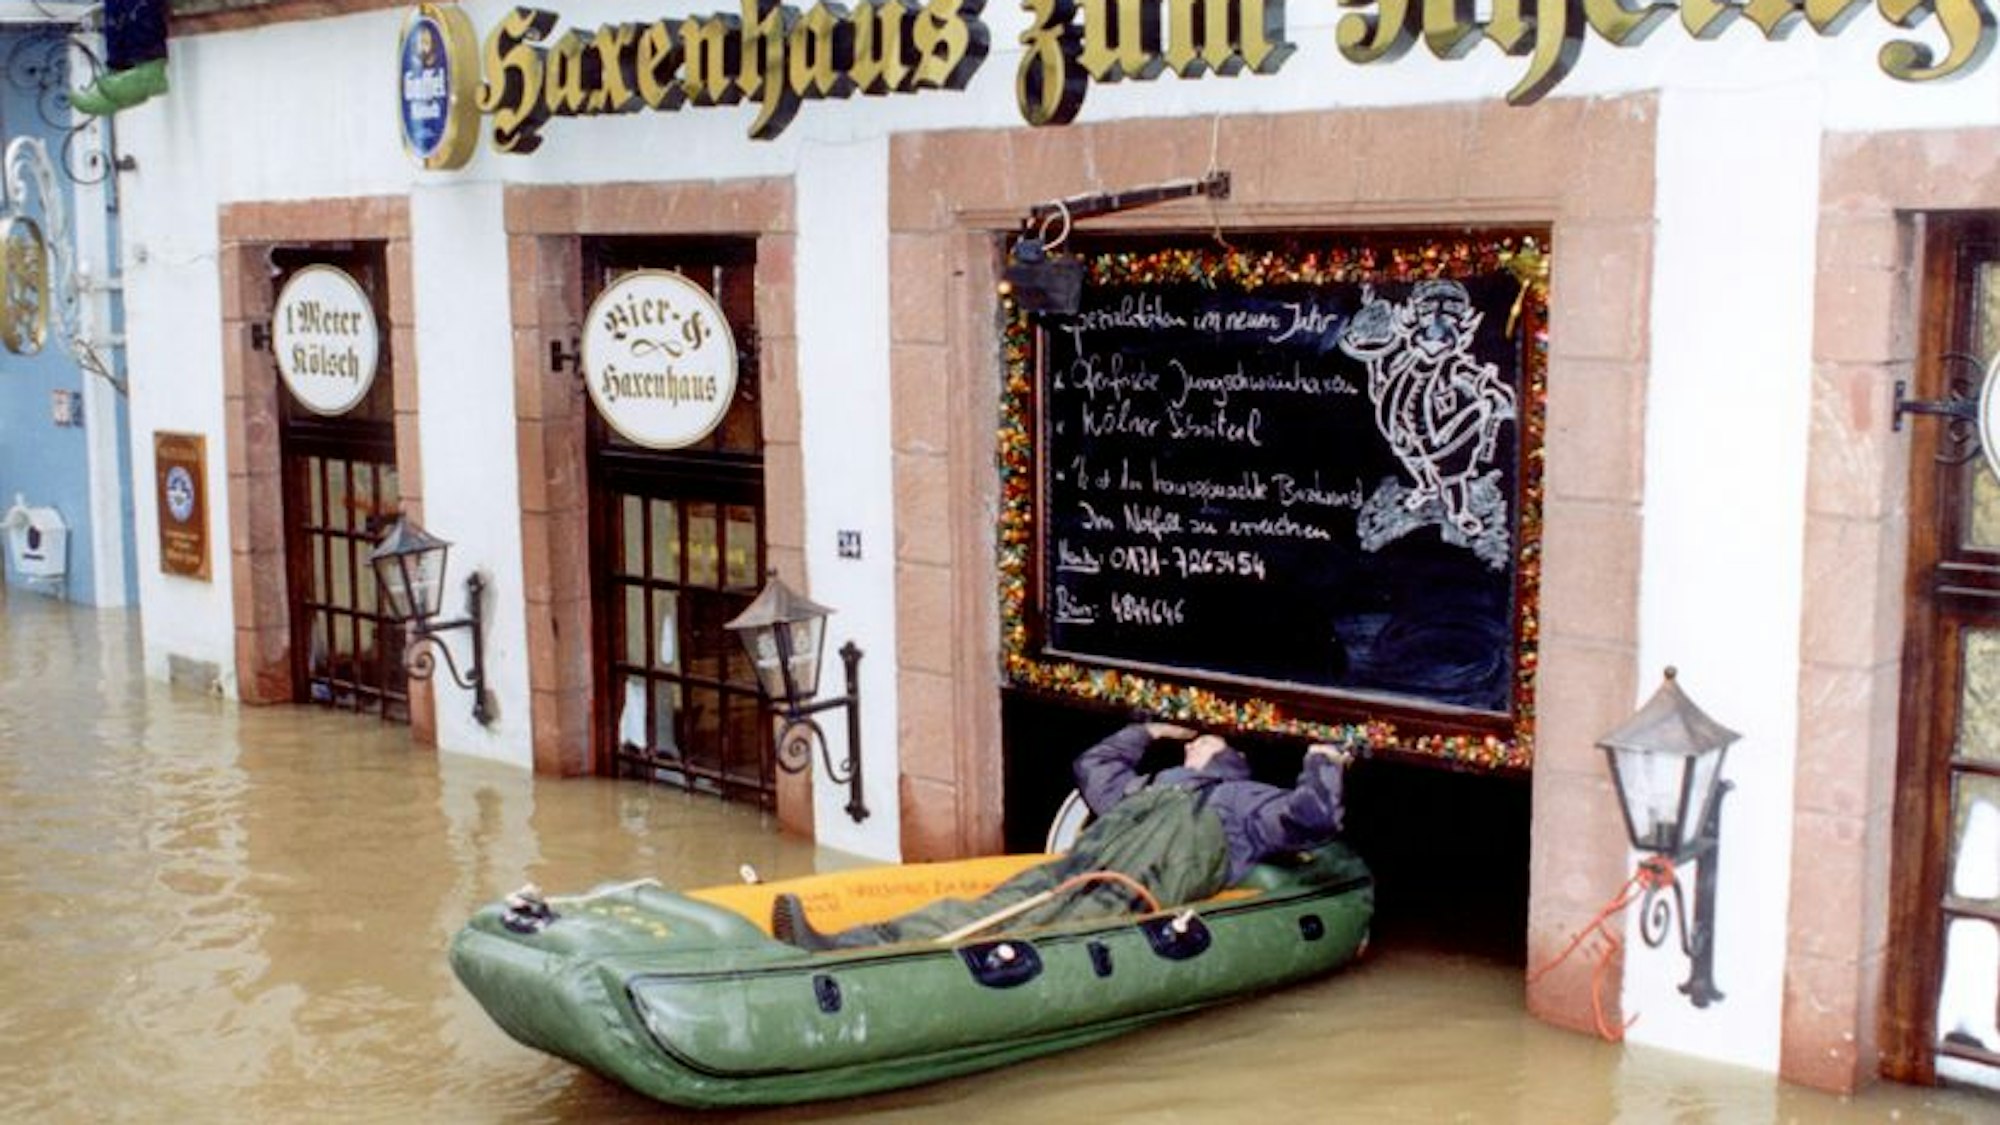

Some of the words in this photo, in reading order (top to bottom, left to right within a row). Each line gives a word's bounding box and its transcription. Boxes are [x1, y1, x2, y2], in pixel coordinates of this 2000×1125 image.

[478, 0, 990, 154] Haxenhaus
[298, 301, 361, 336] Meter
[1193, 308, 1221, 332] im
[1267, 301, 1338, 344] Jahr
[292, 342, 359, 385] Kölsch
[602, 363, 717, 408] Haxenhaus
[1082, 398, 1161, 437] Kölner
[1123, 502, 1184, 542] Notfall
[1188, 519, 1218, 534] zu
